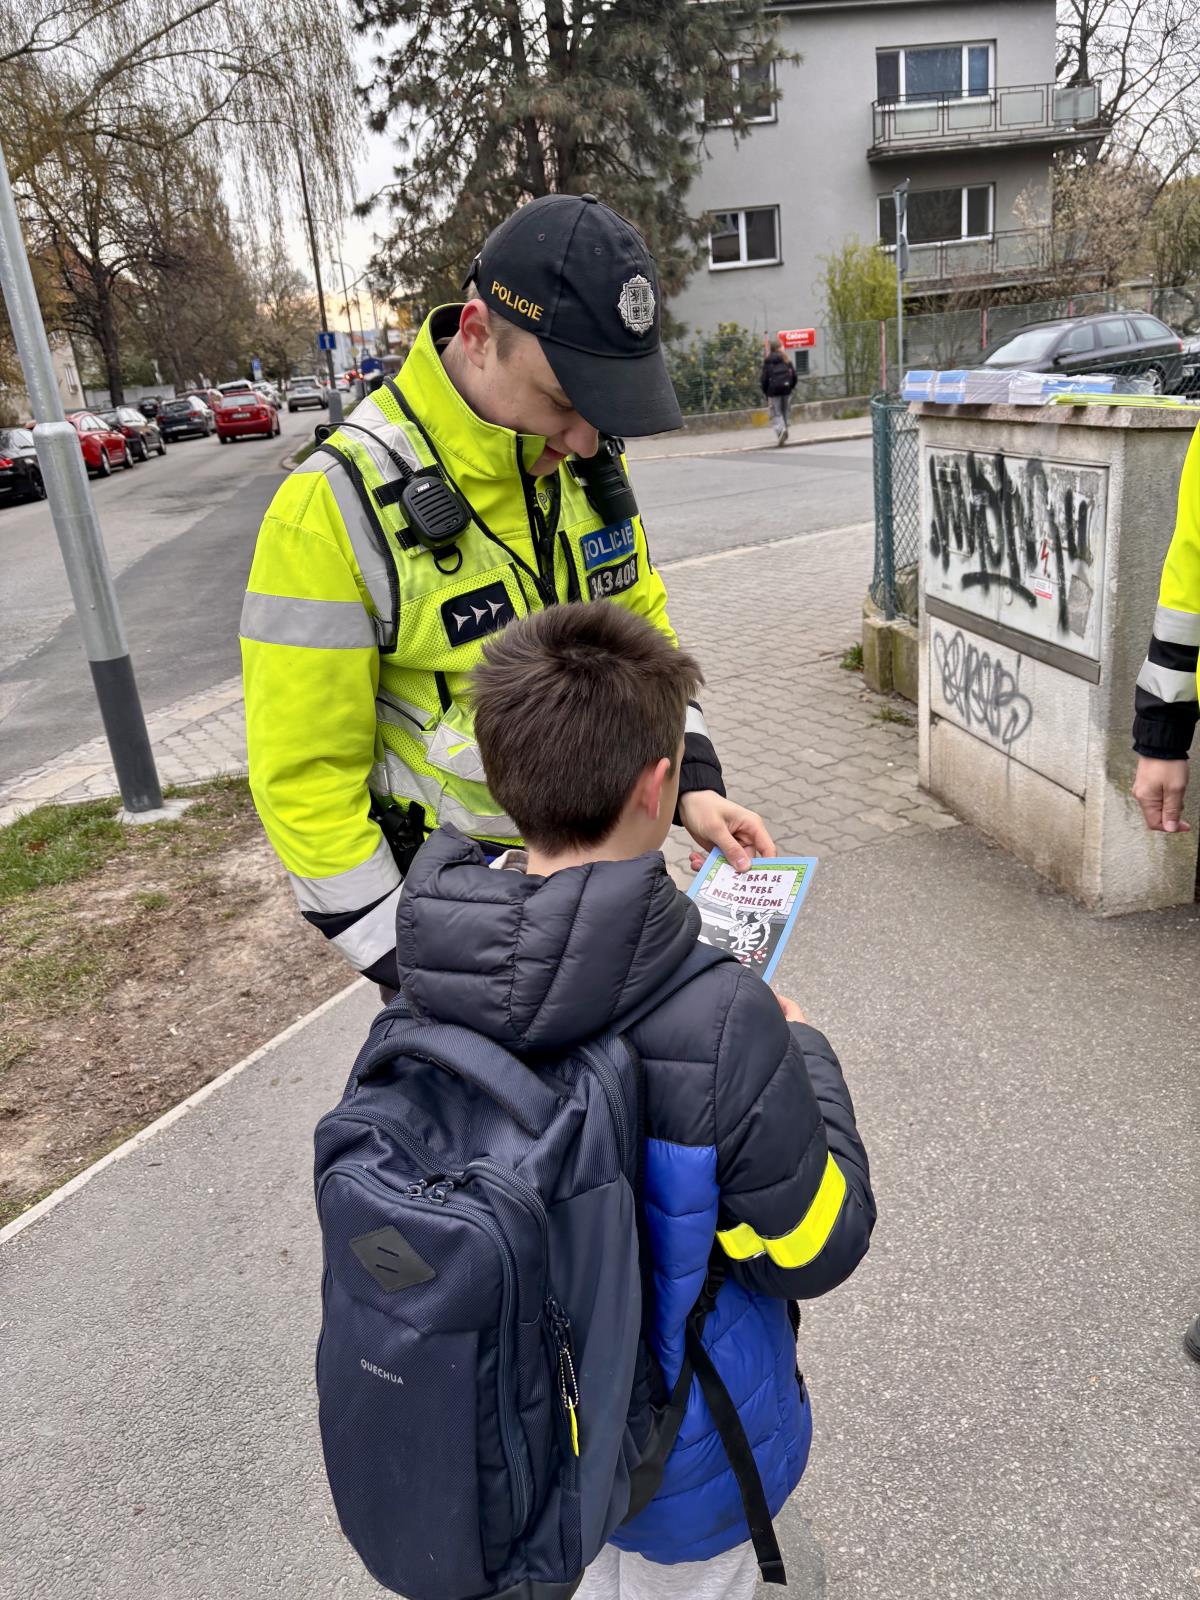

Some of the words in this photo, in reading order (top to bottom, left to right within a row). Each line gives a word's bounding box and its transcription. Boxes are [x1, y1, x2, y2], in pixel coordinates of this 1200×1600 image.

[491, 280, 544, 321] POLICIE
[732, 871, 768, 882] ZBRA
[771, 874, 782, 883] SE
[732, 883, 747, 892] ZA
[750, 885, 774, 894] TEBE
[360, 1358, 404, 1385] QUECHUA
